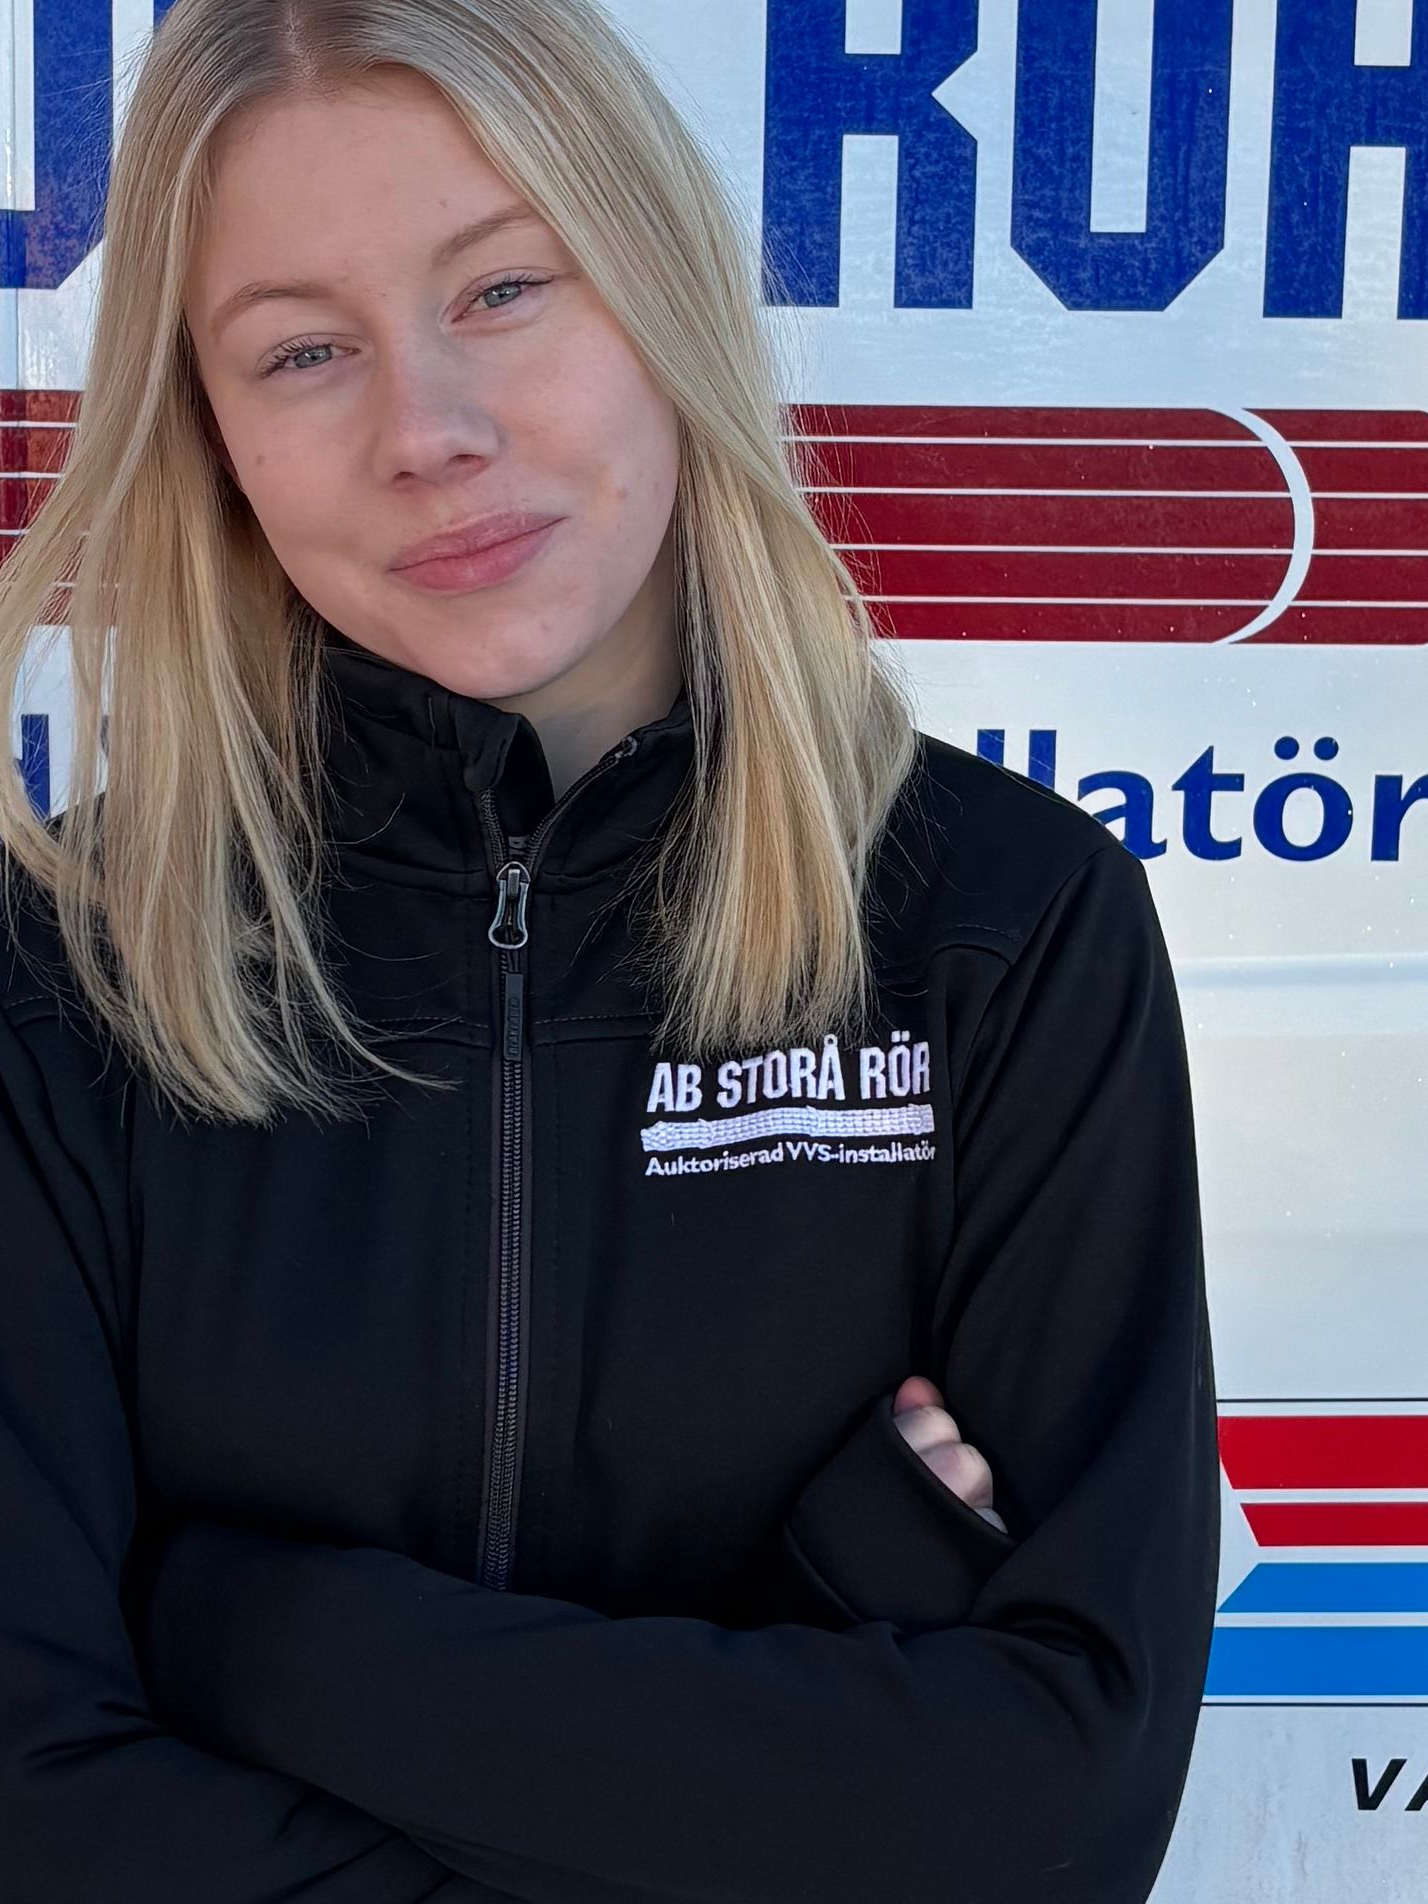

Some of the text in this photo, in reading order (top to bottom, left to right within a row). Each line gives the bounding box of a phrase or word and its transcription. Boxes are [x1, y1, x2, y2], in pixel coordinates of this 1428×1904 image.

[646, 1030, 931, 1113] AB STORÅ RÖR
[645, 1139, 936, 1177] Auktoriserad VVS-installatör
